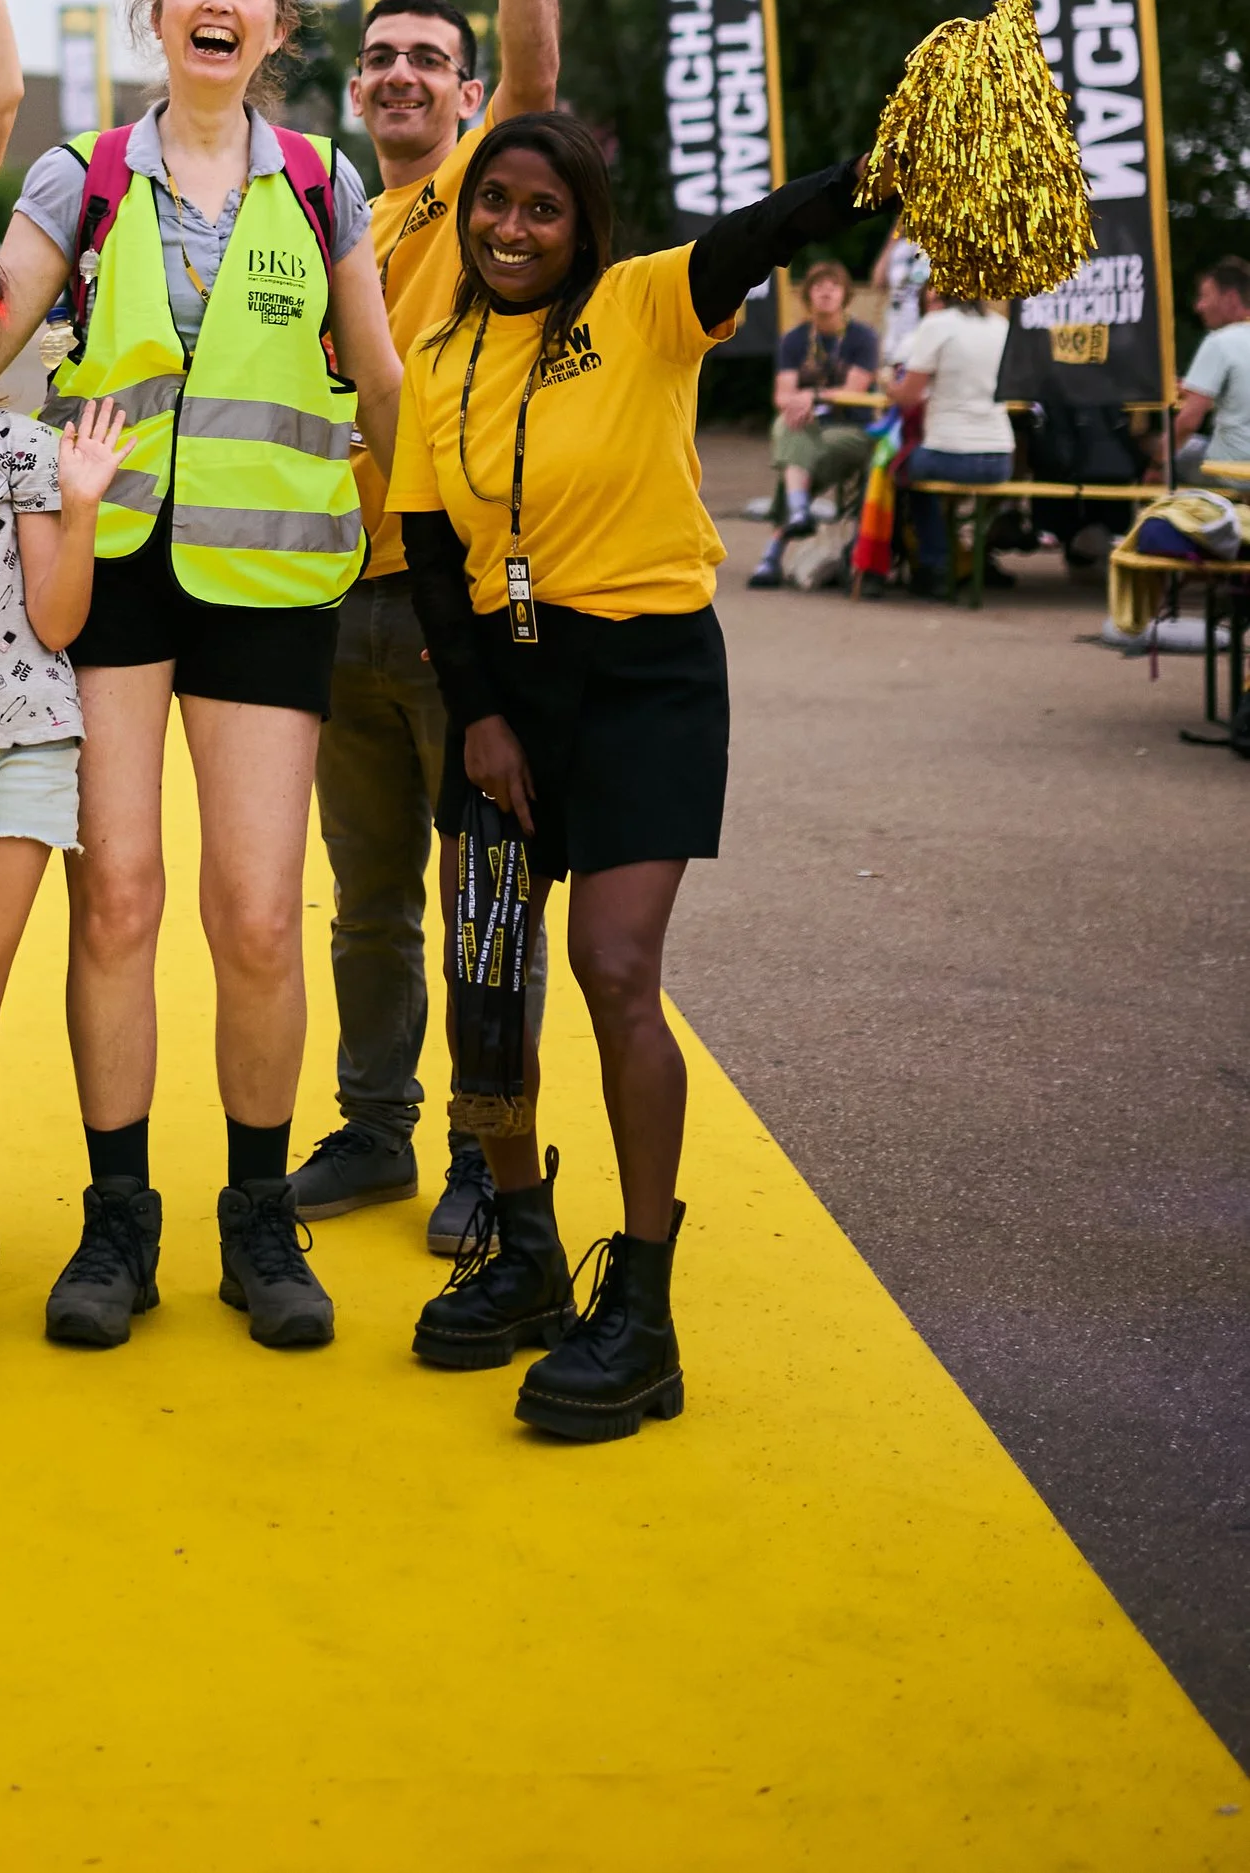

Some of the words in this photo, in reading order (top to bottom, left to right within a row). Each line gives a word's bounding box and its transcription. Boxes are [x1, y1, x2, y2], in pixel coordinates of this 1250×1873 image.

[248, 249, 306, 279] BKB
[248, 291, 294, 306] STICHTING
[248, 301, 303, 319] VLUCHTELING
[268, 313, 288, 325] 999
[565, 358, 577, 368] DE
[10, 659, 26, 678] NOT
[19, 663, 34, 682] CUTE
[482, 940, 491, 949] DE
[479, 949, 489, 962] VAN
[476, 962, 485, 984] NACHT
